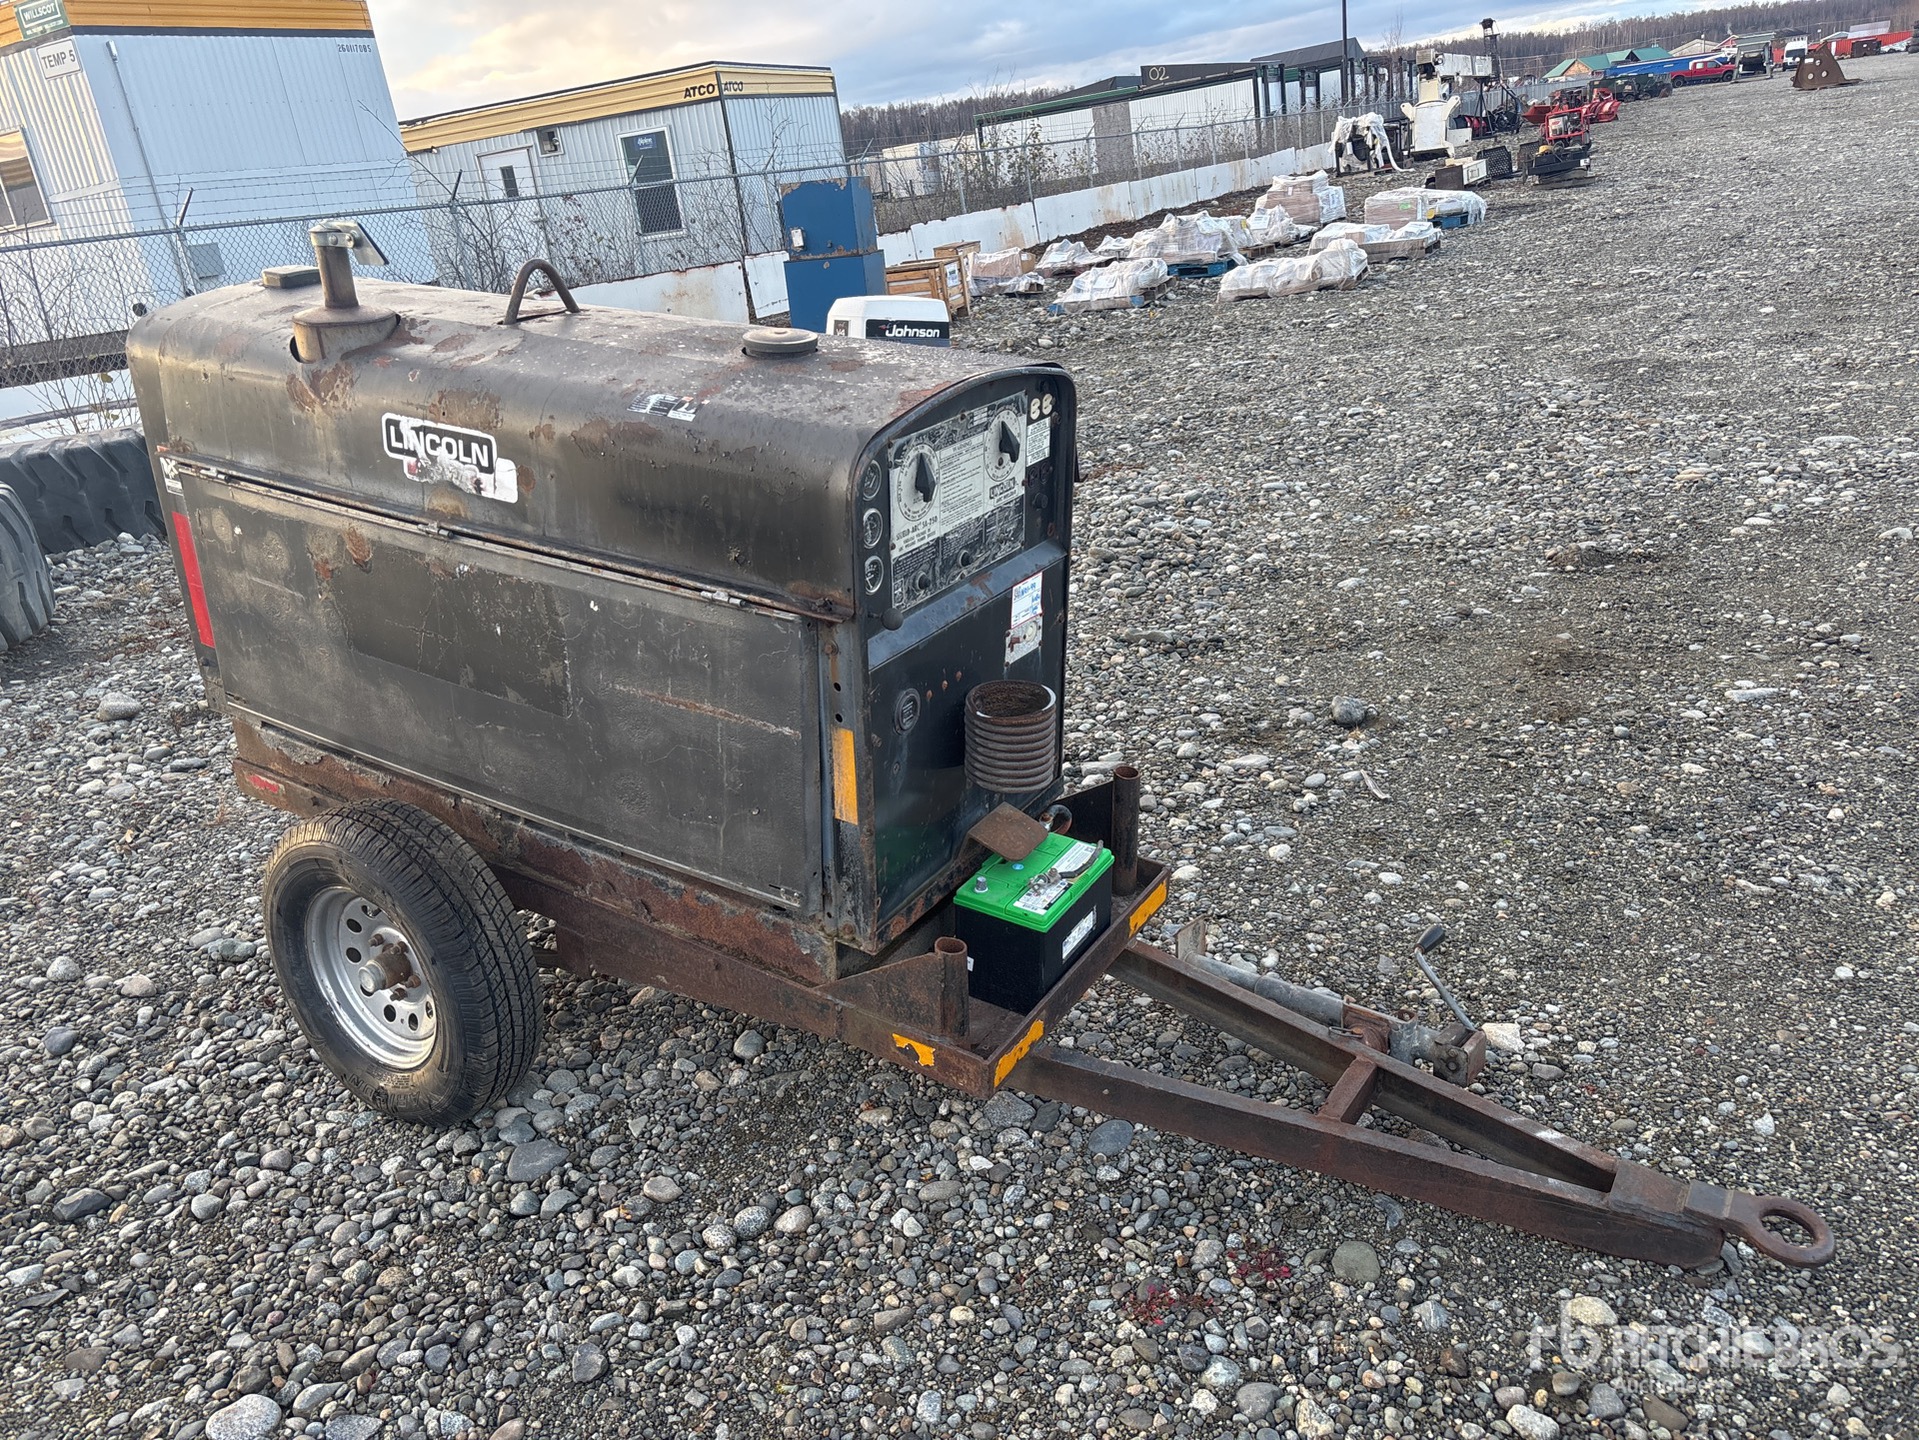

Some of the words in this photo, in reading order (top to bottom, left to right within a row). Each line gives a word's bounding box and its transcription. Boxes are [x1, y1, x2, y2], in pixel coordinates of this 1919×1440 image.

[23, 3, 55, 21] WILLSCOT
[41, 51, 67, 70] TEMP
[68, 49, 77, 63] 5
[684, 83, 716, 99] ATCO
[723, 81, 744, 92] ATCO
[885, 324, 940, 338] Johnson
[390, 425, 489, 468] LINCOLN
